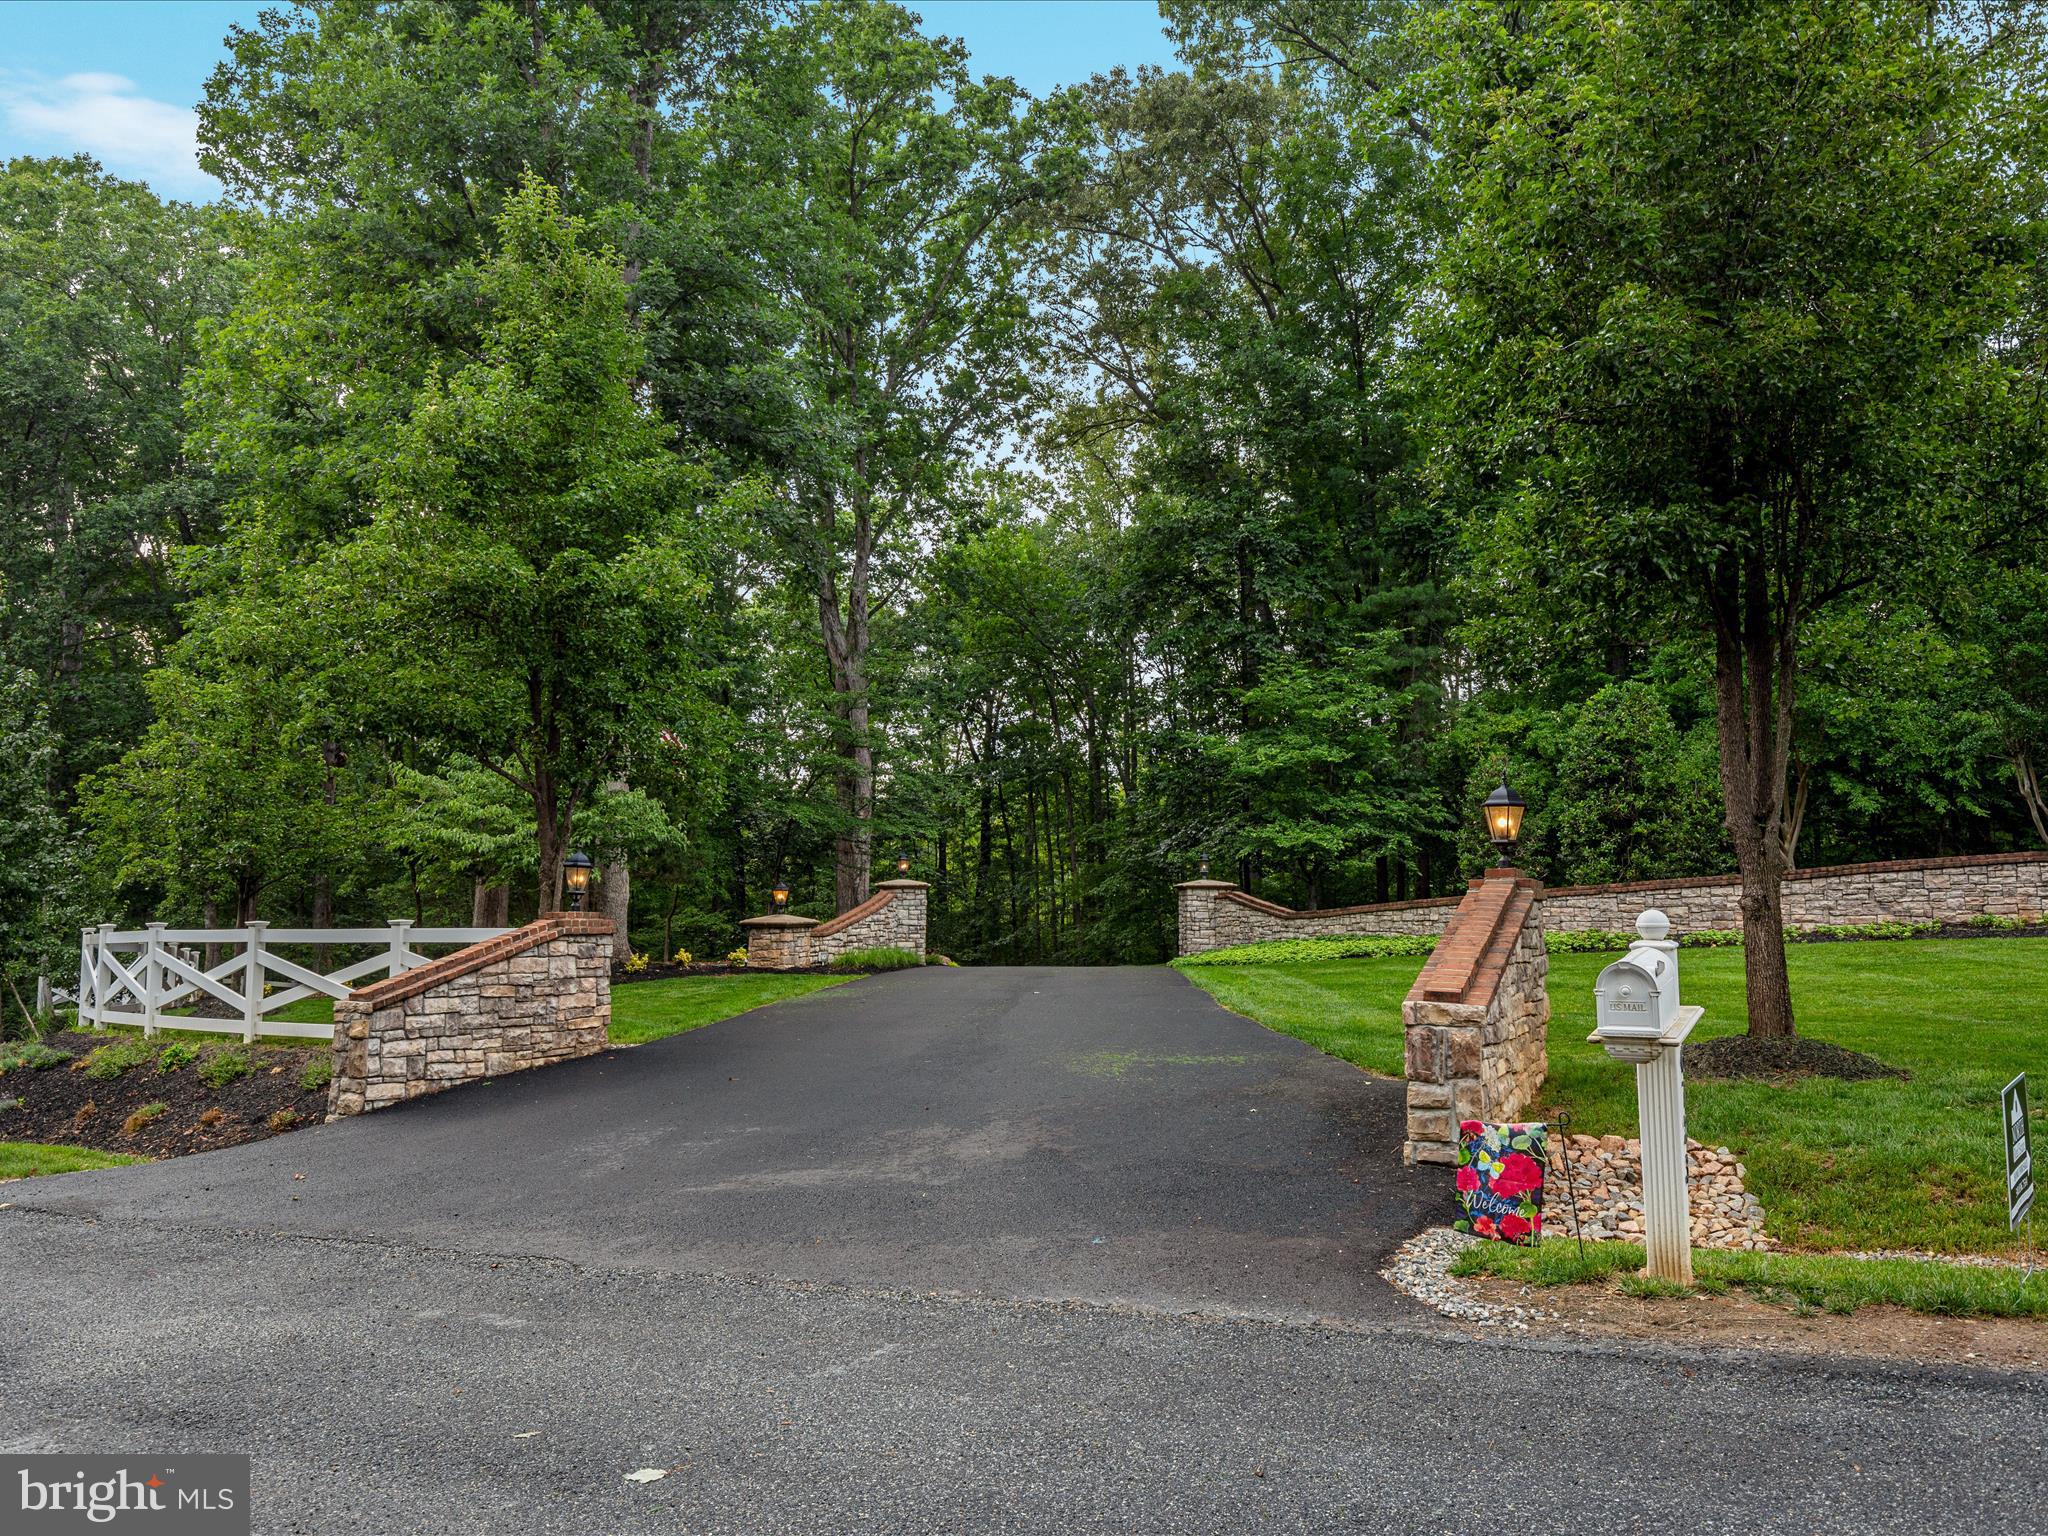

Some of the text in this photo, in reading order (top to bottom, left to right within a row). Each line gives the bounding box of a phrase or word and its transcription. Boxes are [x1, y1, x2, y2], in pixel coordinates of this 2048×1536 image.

[1609, 1003, 1647, 1012] US MAIL
[1466, 1189, 1526, 1218] Welcome
